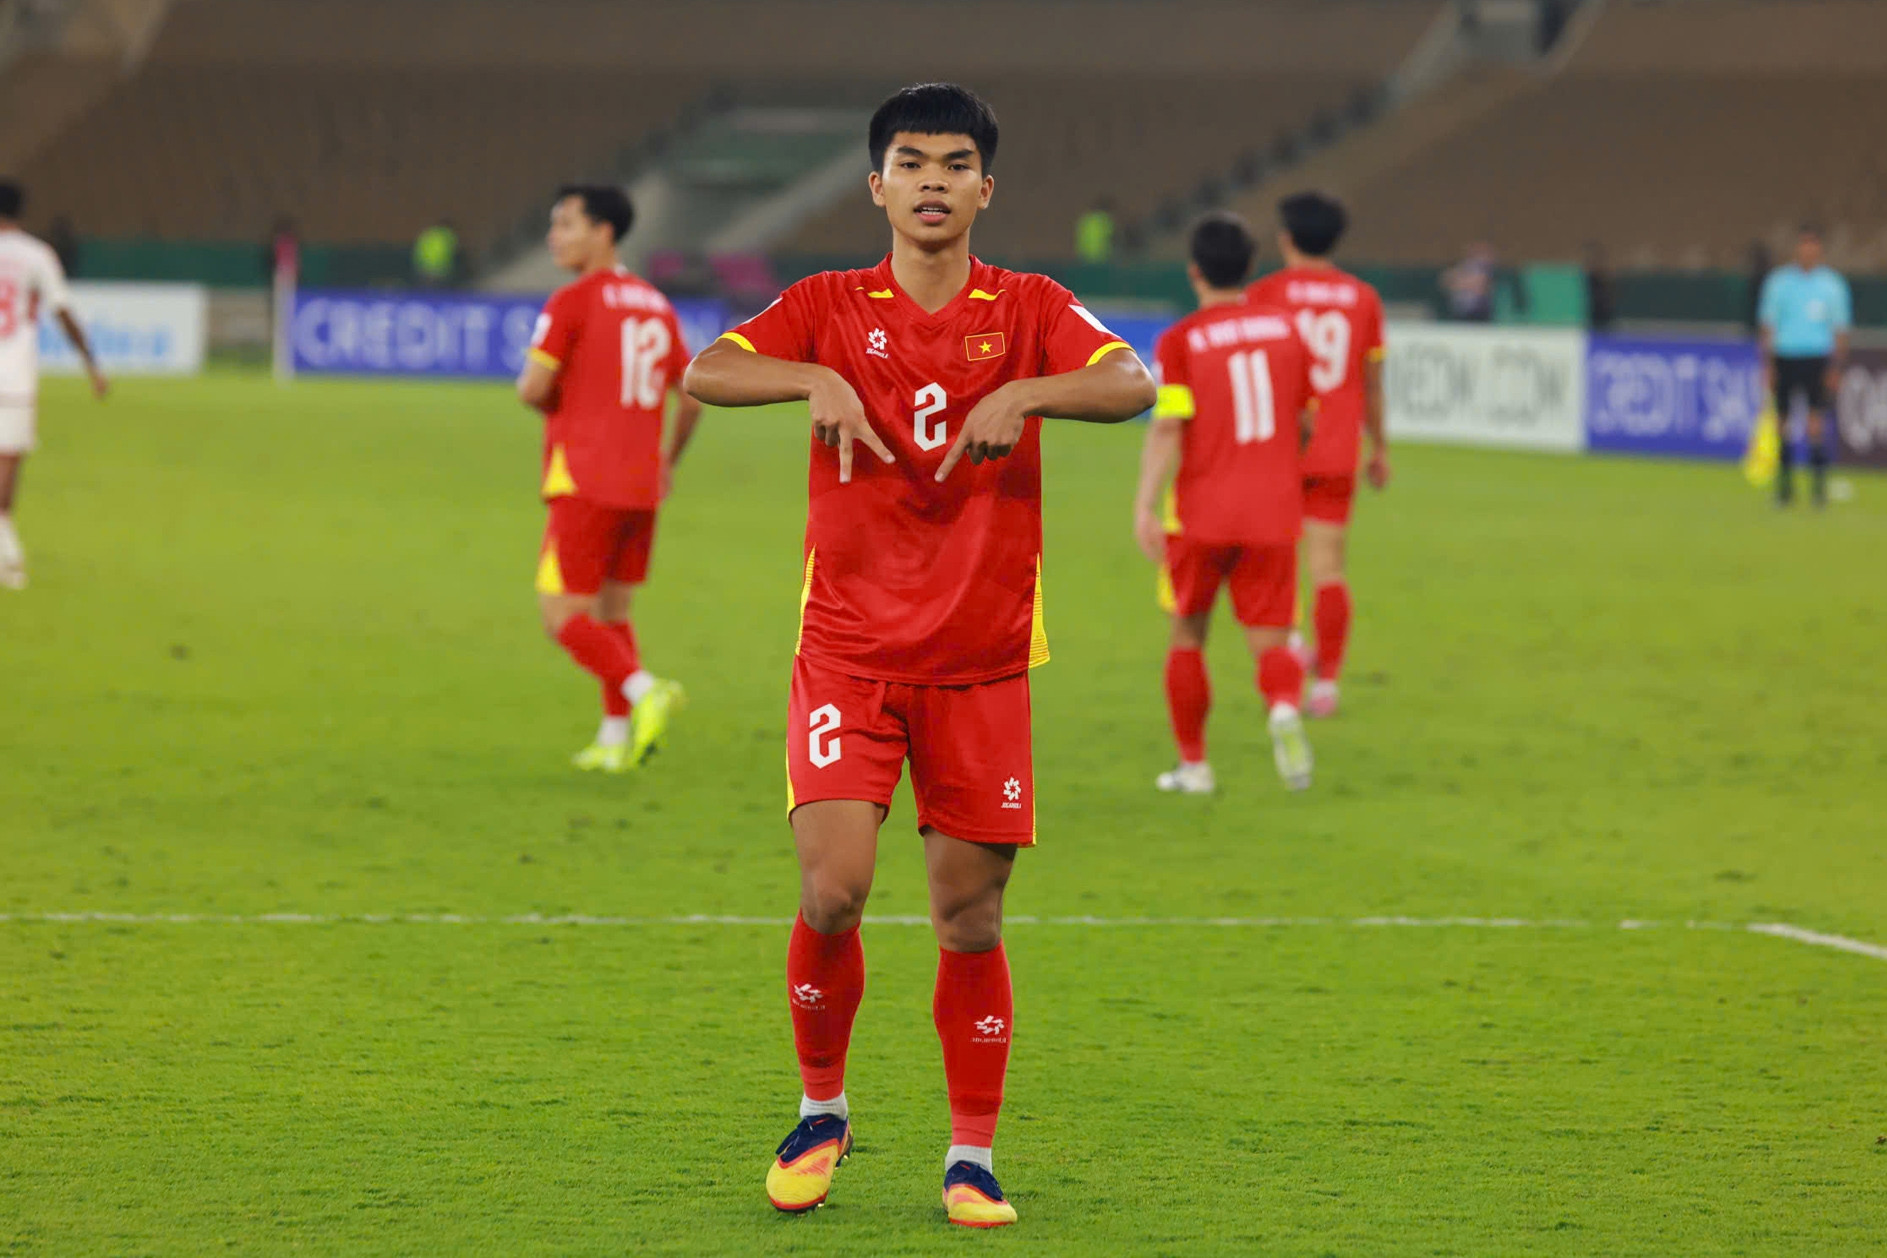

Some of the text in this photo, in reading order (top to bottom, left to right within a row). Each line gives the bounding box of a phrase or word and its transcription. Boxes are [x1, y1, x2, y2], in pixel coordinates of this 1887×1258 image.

[293, 298, 497, 370] CREDIT
[621, 316, 671, 411] 12
[914, 382, 947, 451] 2
[1228, 349, 1275, 444] 11
[809, 703, 841, 769] 2
